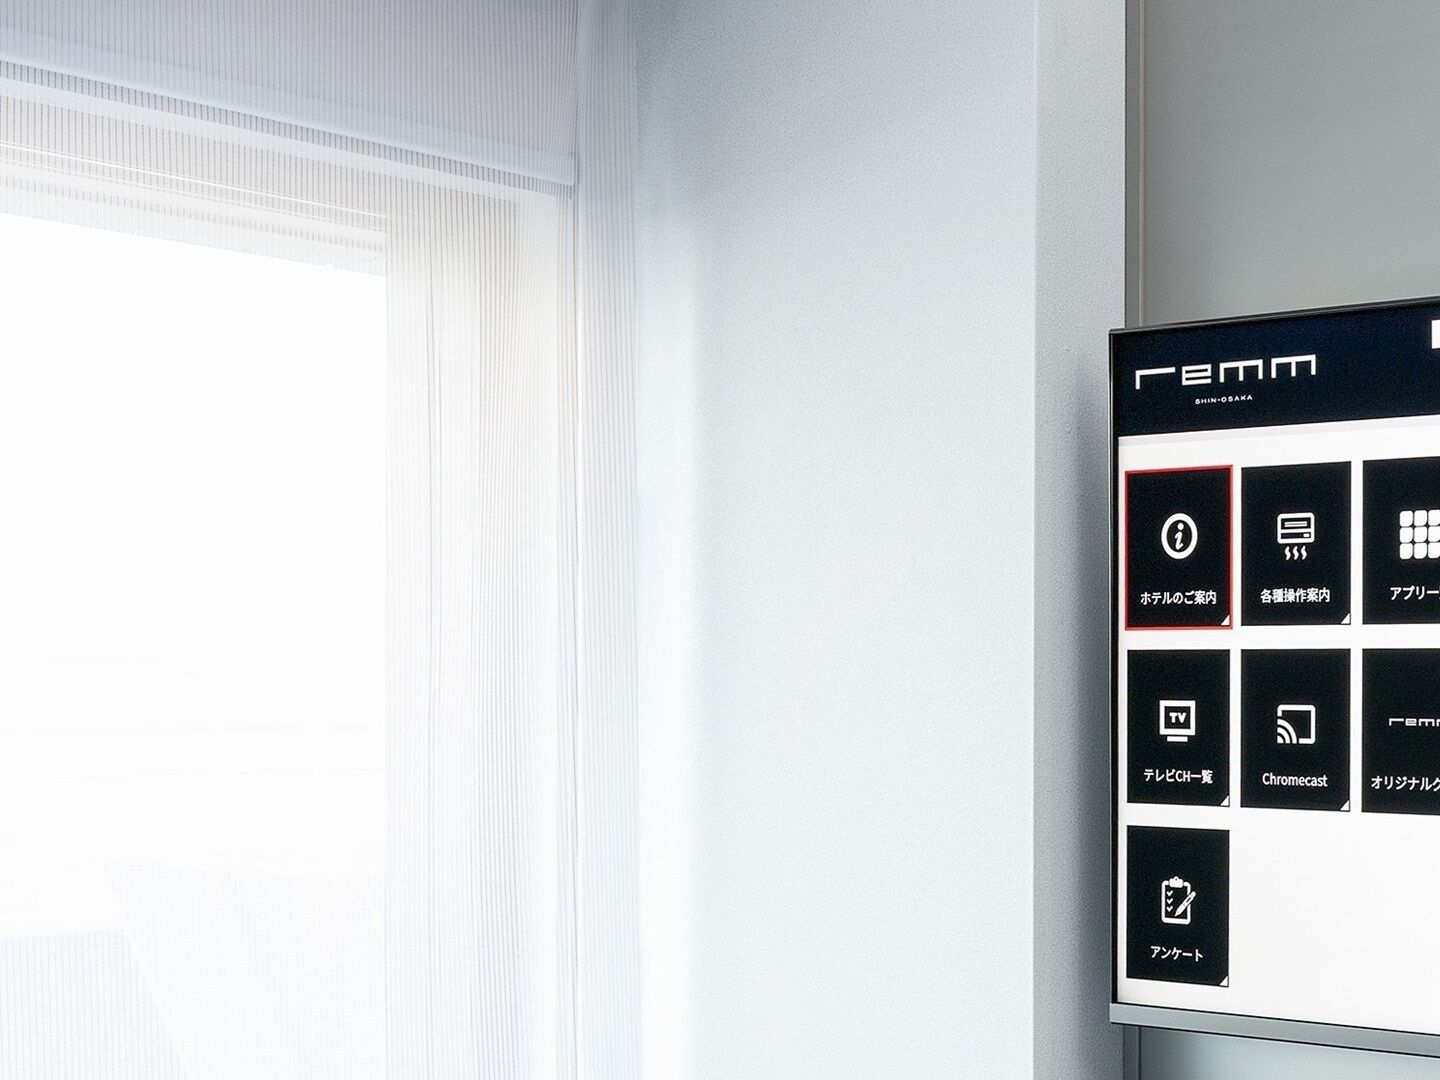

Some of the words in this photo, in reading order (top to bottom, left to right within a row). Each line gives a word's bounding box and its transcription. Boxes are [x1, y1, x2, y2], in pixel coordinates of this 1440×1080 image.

[1135, 354, 1316, 389] remm
[1141, 590, 1216, 605] ホテルのご案内
[1261, 587, 1330, 603] 各種操作案内
[1167, 710, 1188, 724] TV
[1144, 769, 1213, 784] テレビCH一覧
[1262, 773, 1328, 787] Chromecast
[1151, 946, 1203, 961] アンケート
